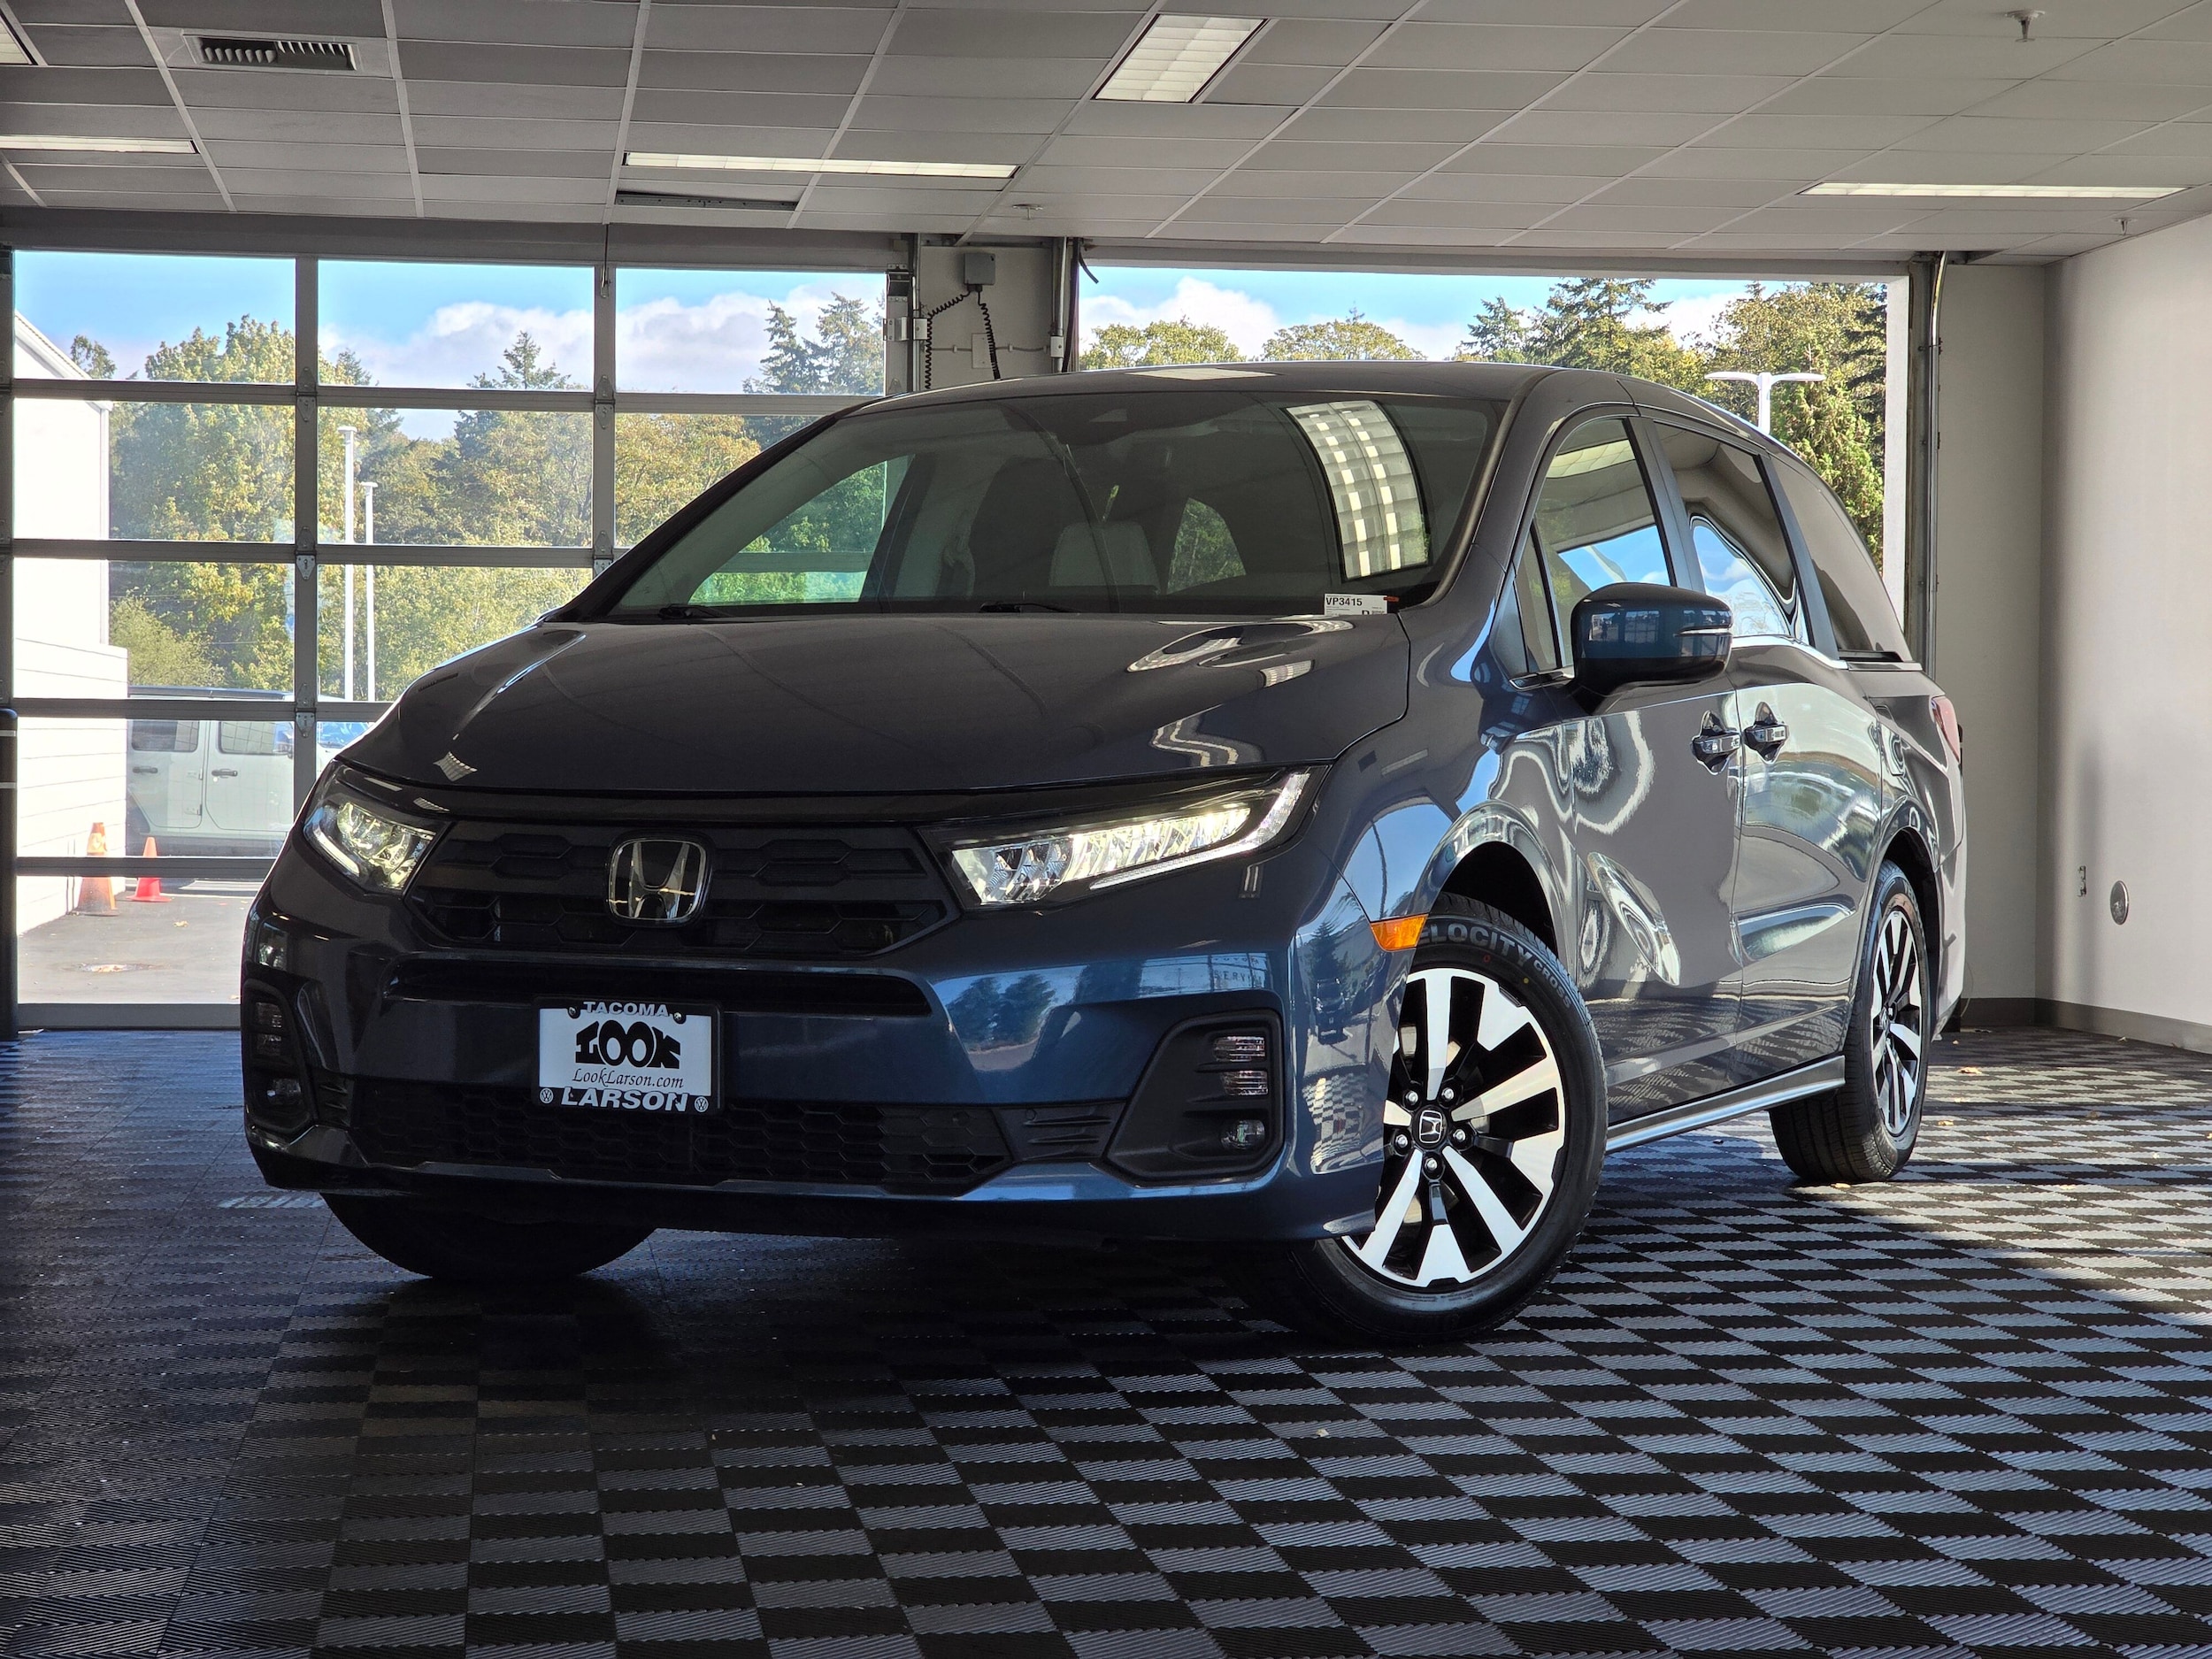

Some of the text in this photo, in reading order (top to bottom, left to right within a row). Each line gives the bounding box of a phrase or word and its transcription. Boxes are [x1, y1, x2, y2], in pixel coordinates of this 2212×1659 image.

[1325, 596, 1363, 606] VP3415
[1417, 922, 1572, 1009] ELOCITY CROSS
[582, 1001, 670, 1018] TACOMA
[575, 1019, 681, 1070] LOOK
[572, 1067, 684, 1088] LookLarson.com
[560, 1087, 690, 1112] LARSON
